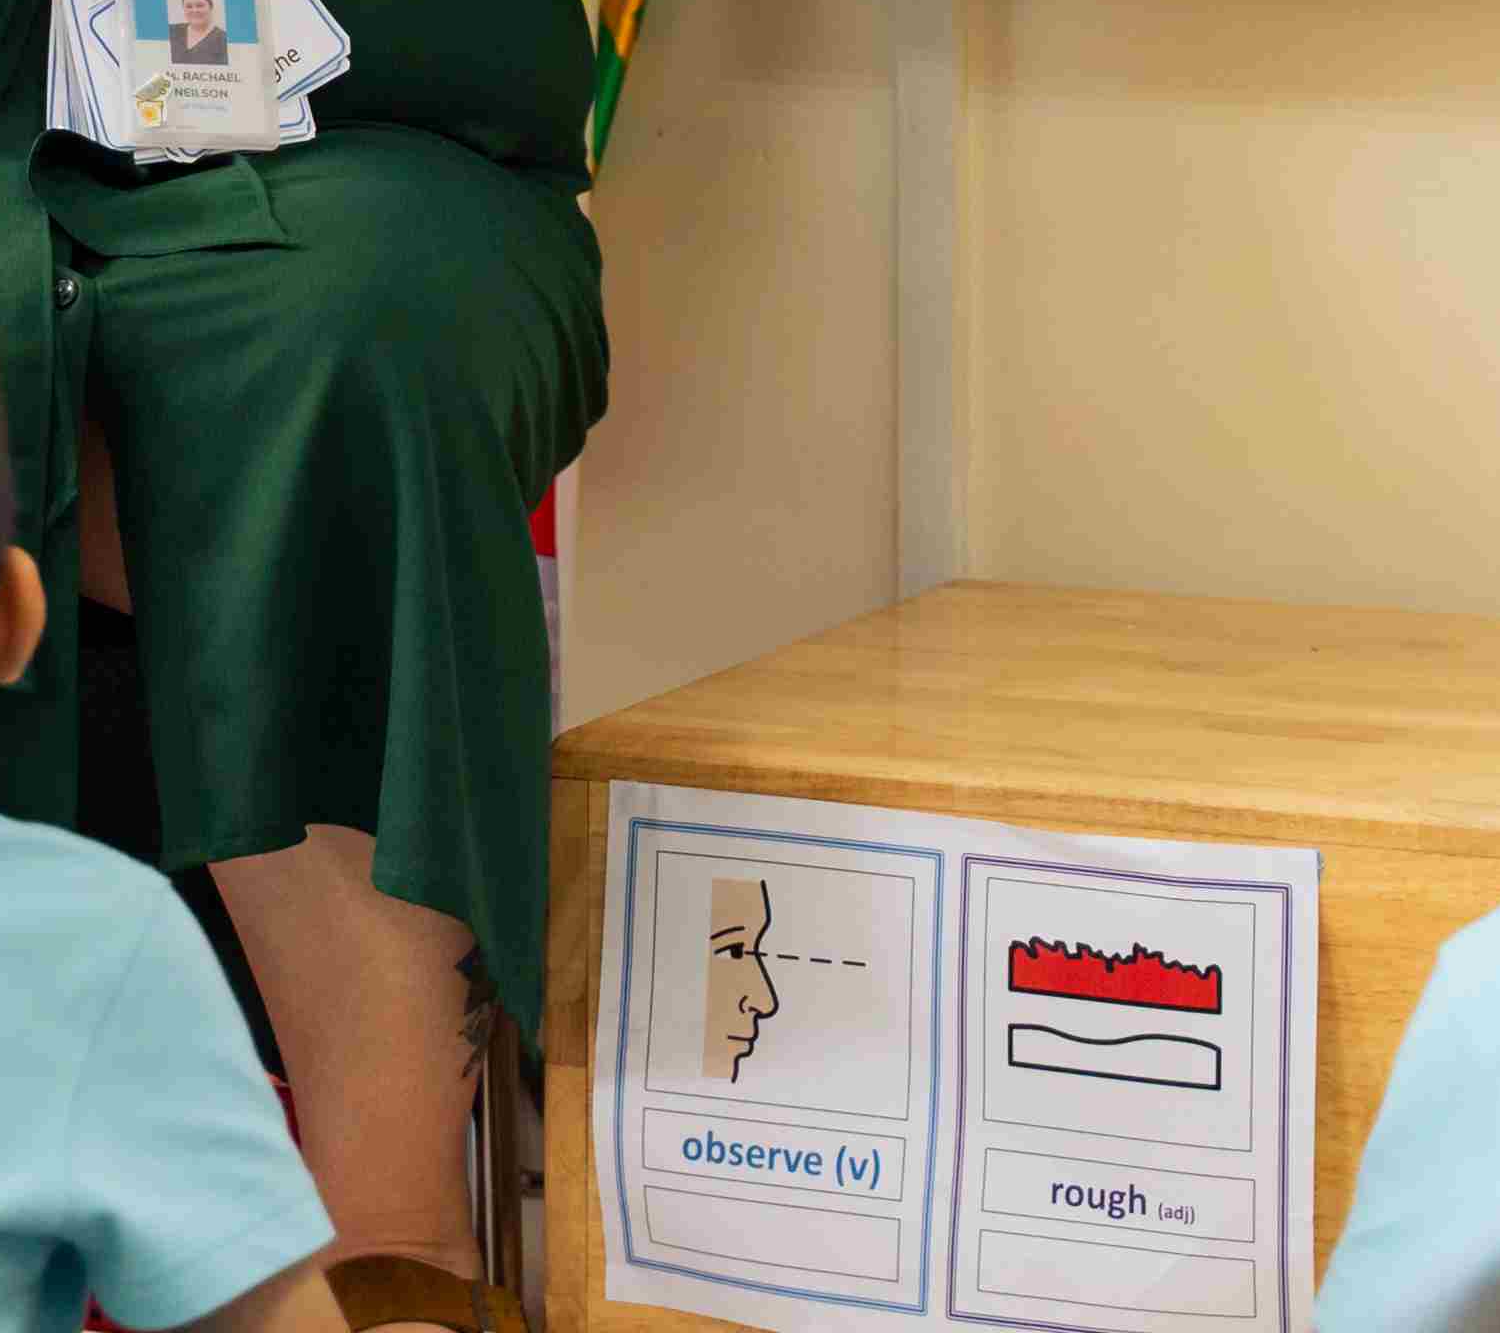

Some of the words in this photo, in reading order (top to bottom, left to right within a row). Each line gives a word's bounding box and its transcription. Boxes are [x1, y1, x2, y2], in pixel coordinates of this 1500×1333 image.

[182, 70, 242, 83] RACHAEL
[173, 88, 229, 99] NEILSON
[681, 1130, 824, 1178] observe
[834, 1145, 883, 1191] (v)
[1050, 1178, 1148, 1220] rough
[1157, 1198, 1197, 1225] (adj)
